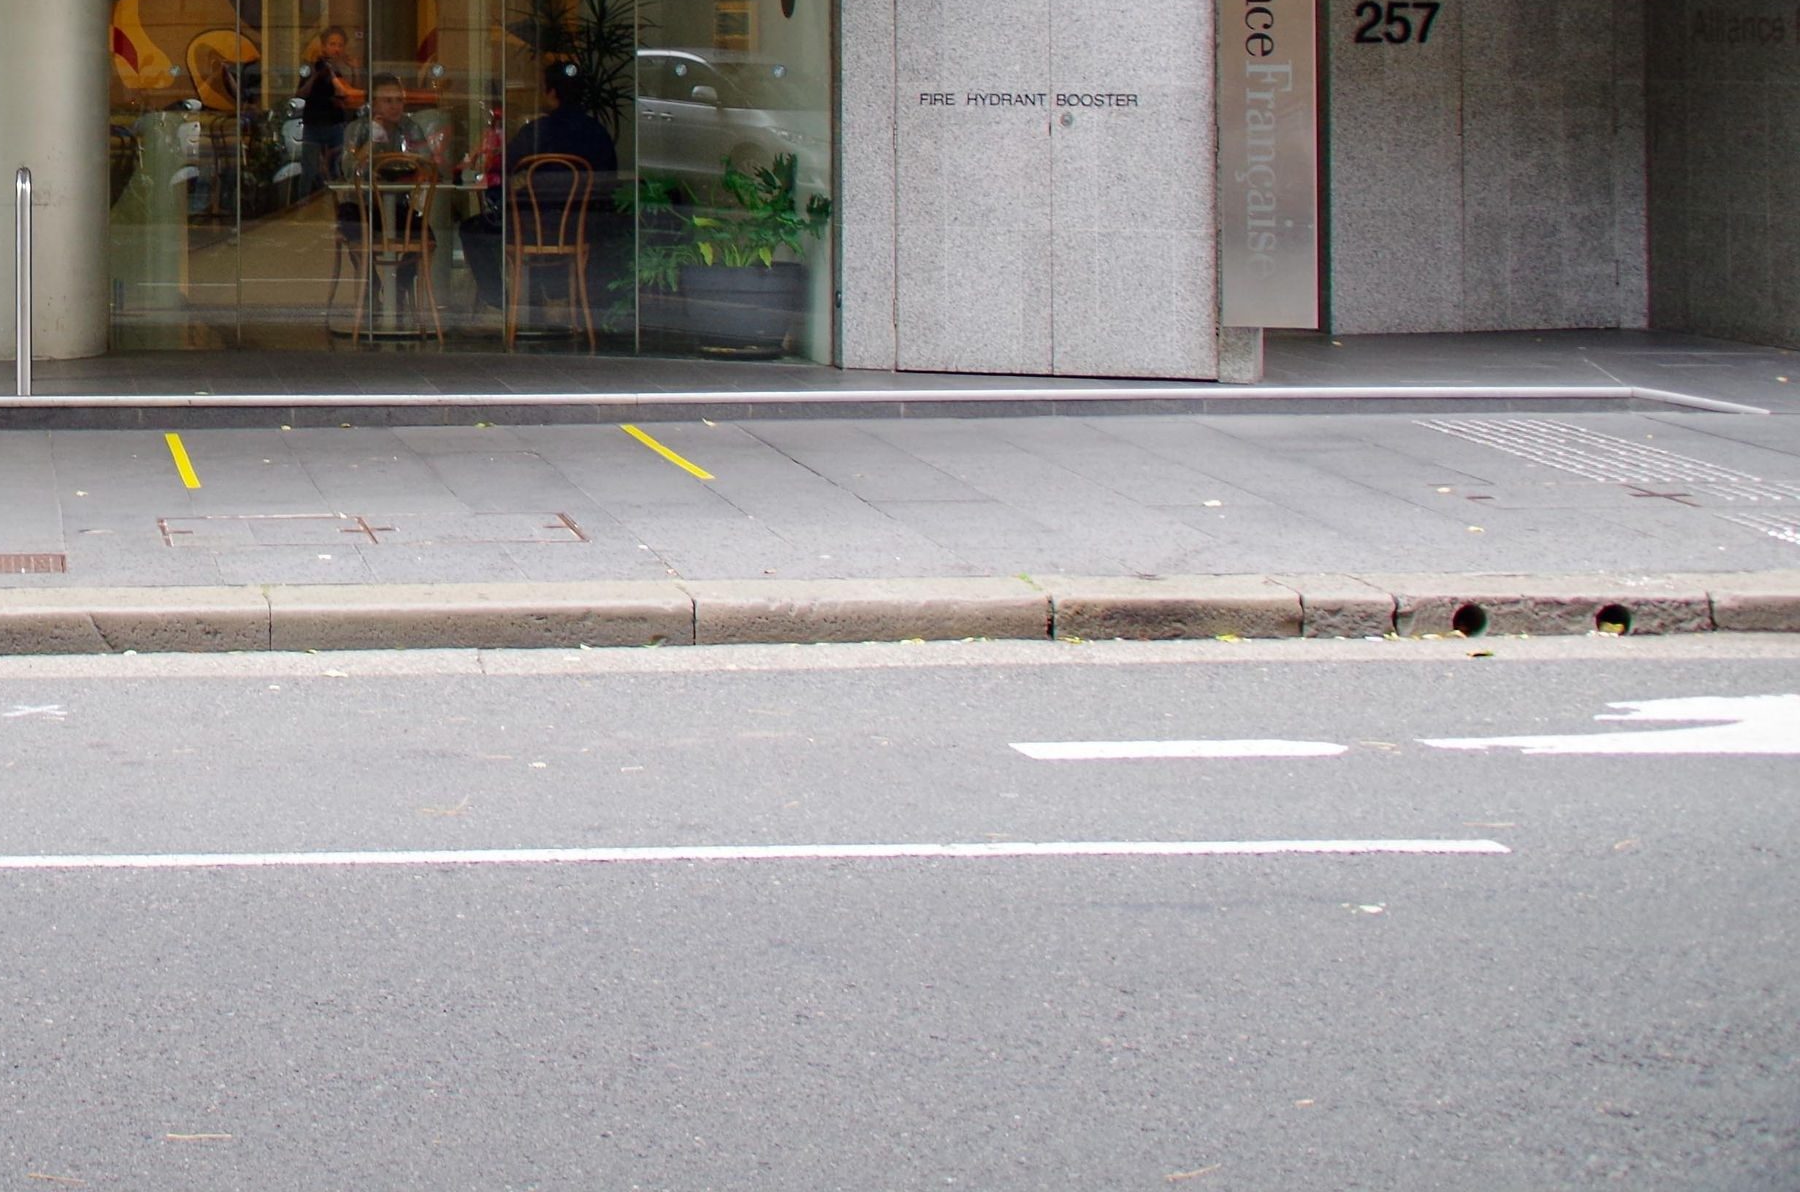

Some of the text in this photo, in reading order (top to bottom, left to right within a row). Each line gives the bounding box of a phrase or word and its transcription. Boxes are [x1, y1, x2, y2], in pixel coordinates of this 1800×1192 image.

[1353, 1, 1441, 44] 257
[919, 92, 1139, 108] FIRE HYDRANT BOOSTER
[1233, 60, 1294, 282] Française
